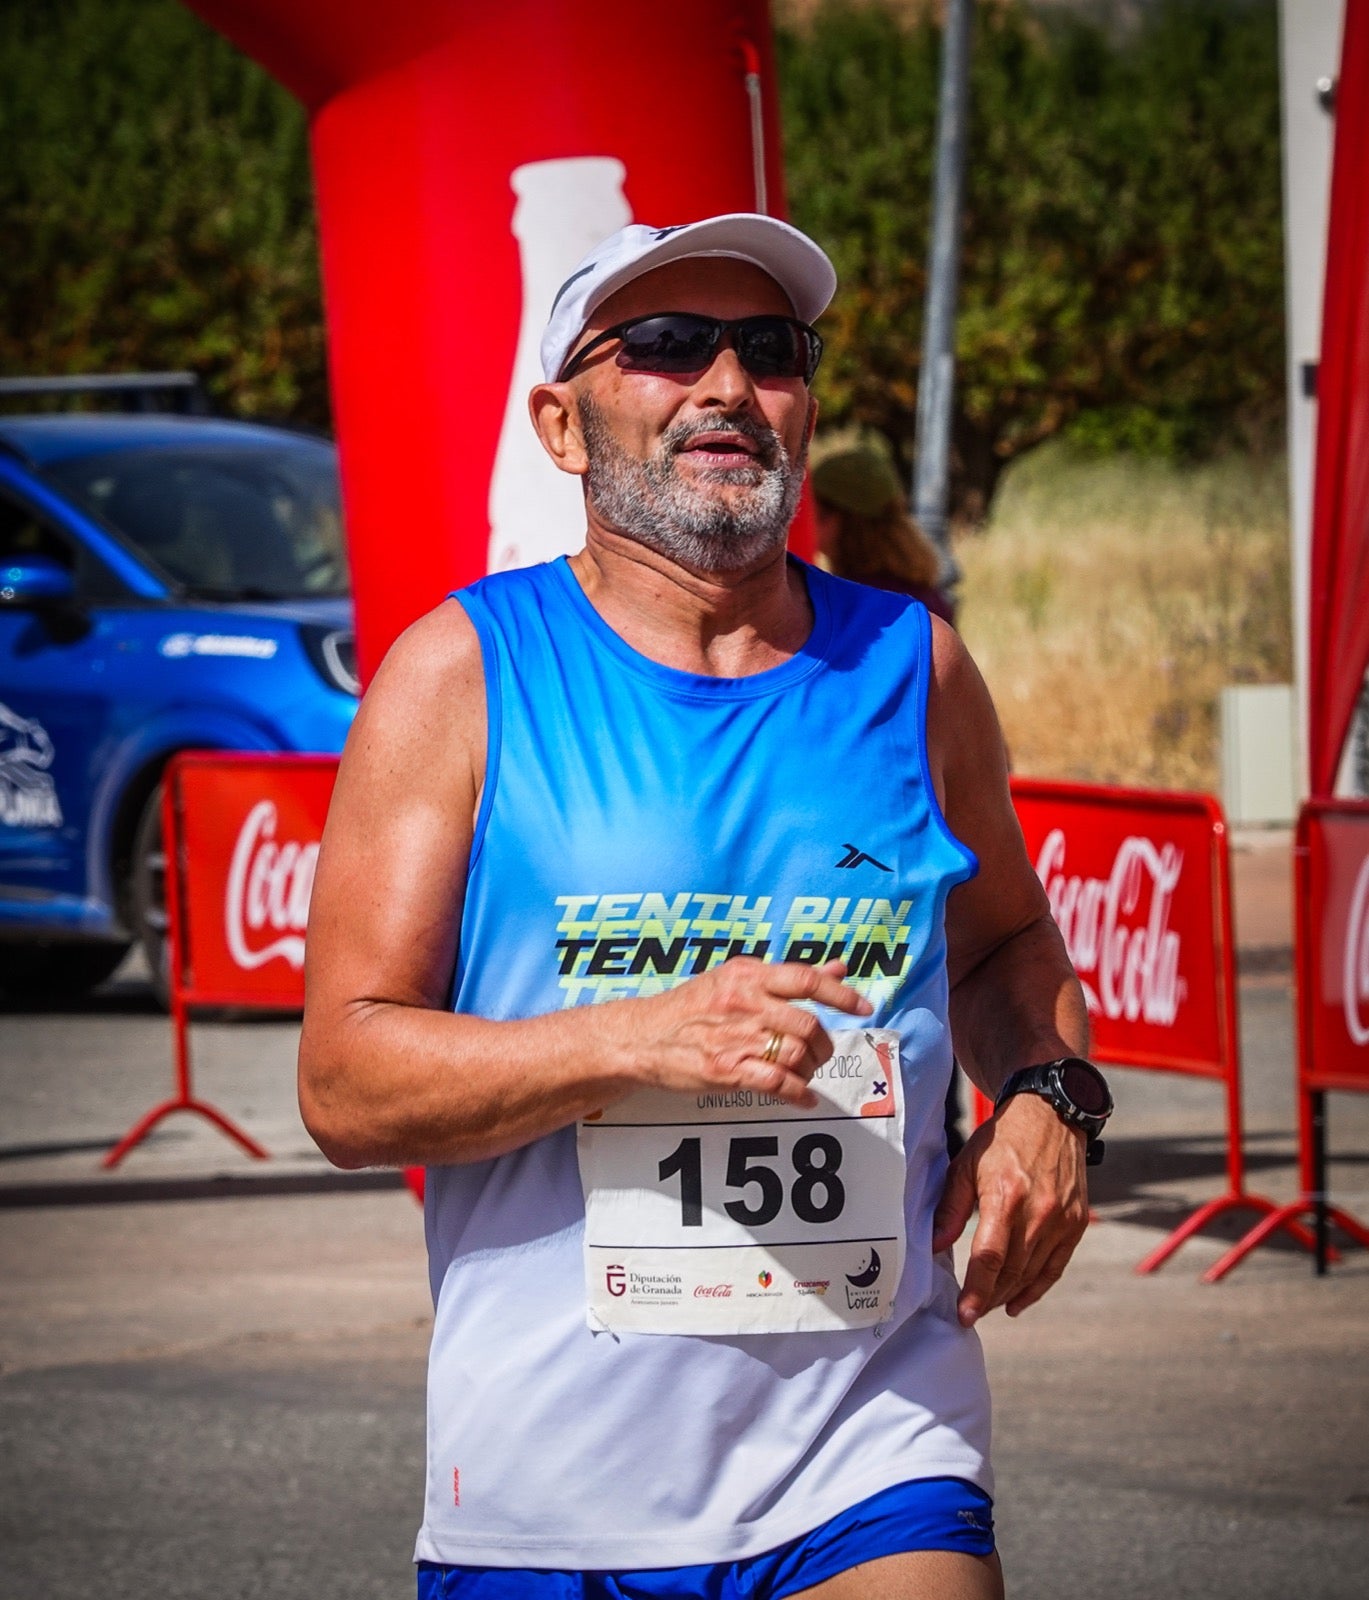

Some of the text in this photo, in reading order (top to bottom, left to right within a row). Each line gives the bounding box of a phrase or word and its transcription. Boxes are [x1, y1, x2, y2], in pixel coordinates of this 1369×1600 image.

[554, 892, 913, 934] TENTH RUN
[555, 937, 910, 977] TENTH RUN
[829, 1055, 863, 1079] 2022
[697, 1090, 791, 1109] UNIVERSO LOR
[658, 1132, 845, 1227] 158
[630, 1273, 682, 1284] Diputación
[630, 1285, 682, 1294] de Granada
[845, 1284, 879, 1310] Lorca
